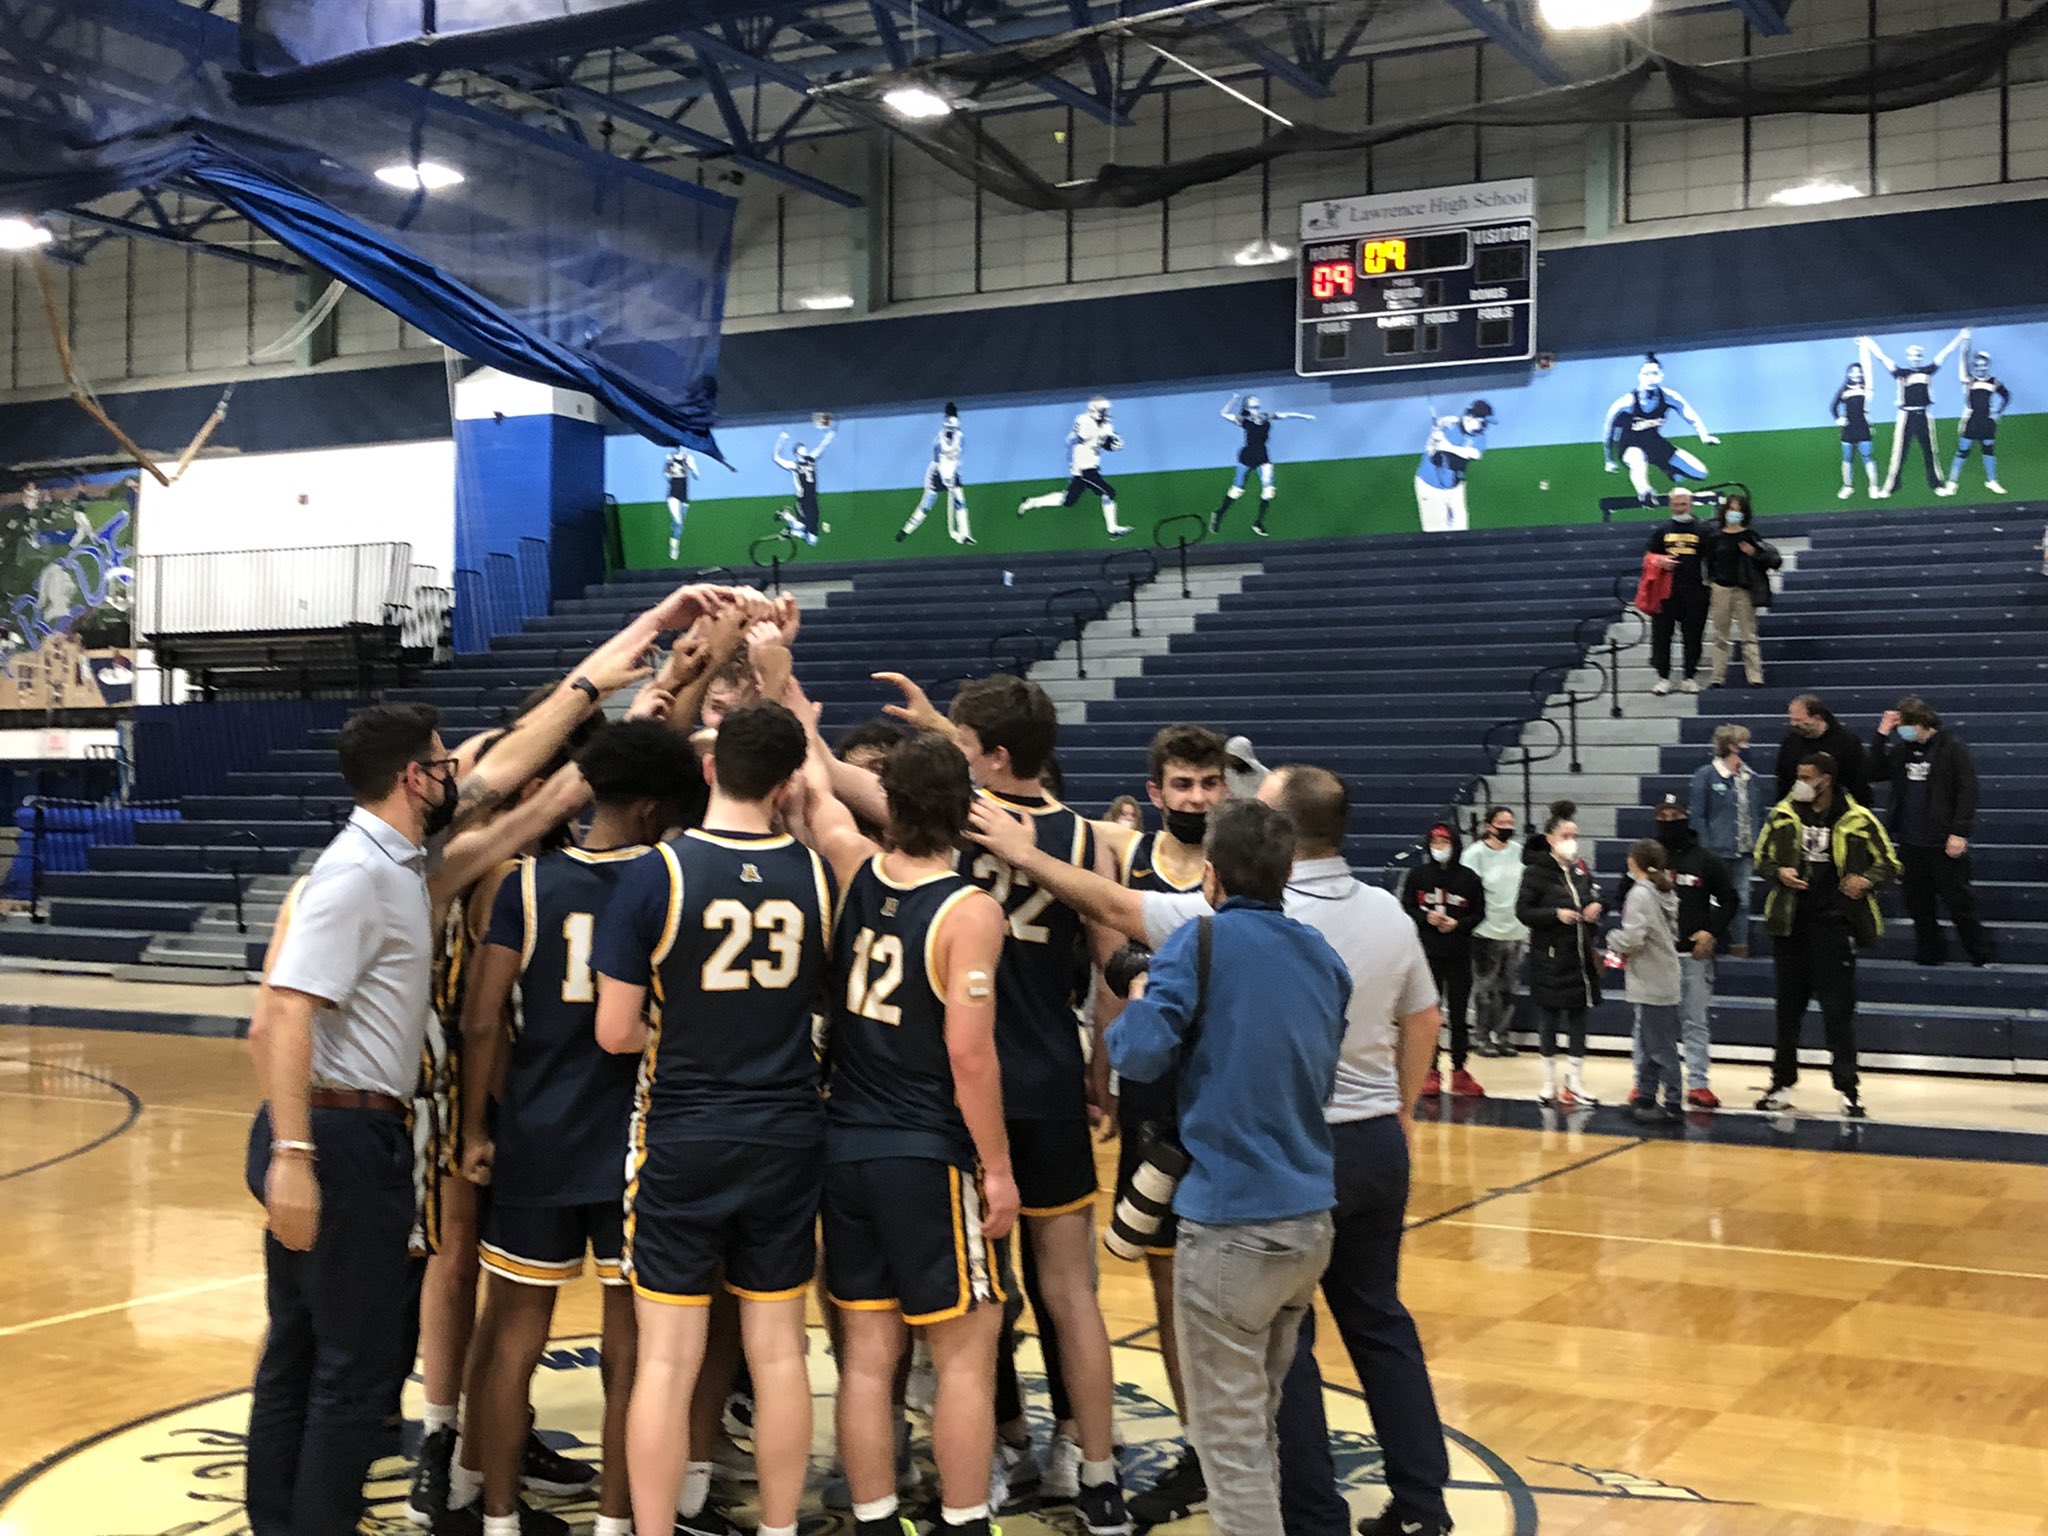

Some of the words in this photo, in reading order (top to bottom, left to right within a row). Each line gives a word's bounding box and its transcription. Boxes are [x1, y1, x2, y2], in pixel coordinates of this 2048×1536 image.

[1350, 203, 1425, 222] Lawrence
[1430, 196, 1468, 215] High
[1473, 188, 1528, 209] School
[1474, 226, 1530, 244] VISITOR
[1309, 244, 1350, 261] HOME
[1364, 240, 1406, 274] 09
[1312, 263, 1354, 298] 09
[561, 912, 595, 1003] 1
[701, 898, 805, 991] 23
[847, 926, 904, 1026] 12
